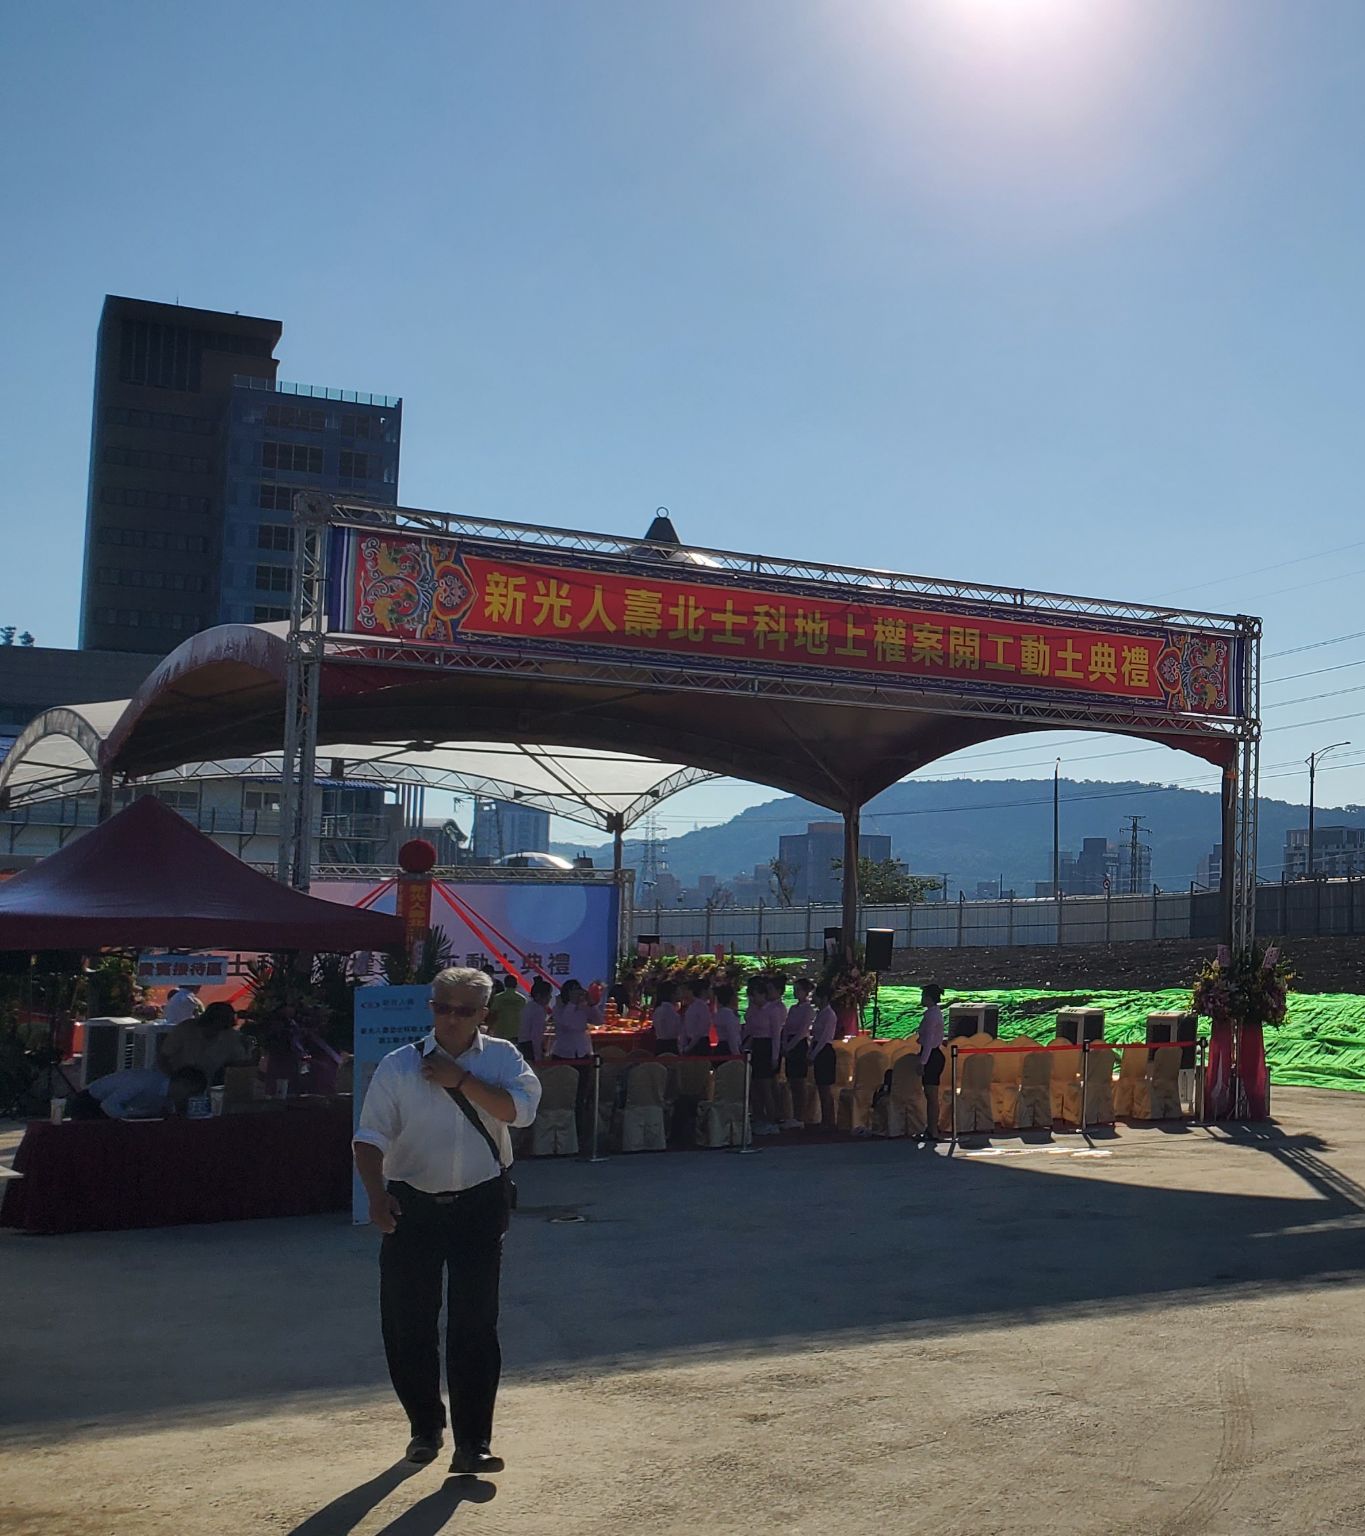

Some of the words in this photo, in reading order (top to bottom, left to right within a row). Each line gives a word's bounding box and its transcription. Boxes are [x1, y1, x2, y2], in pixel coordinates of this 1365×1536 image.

[484, 572, 1151, 689] 新光人壽北士科地上權案開工動土典禮
